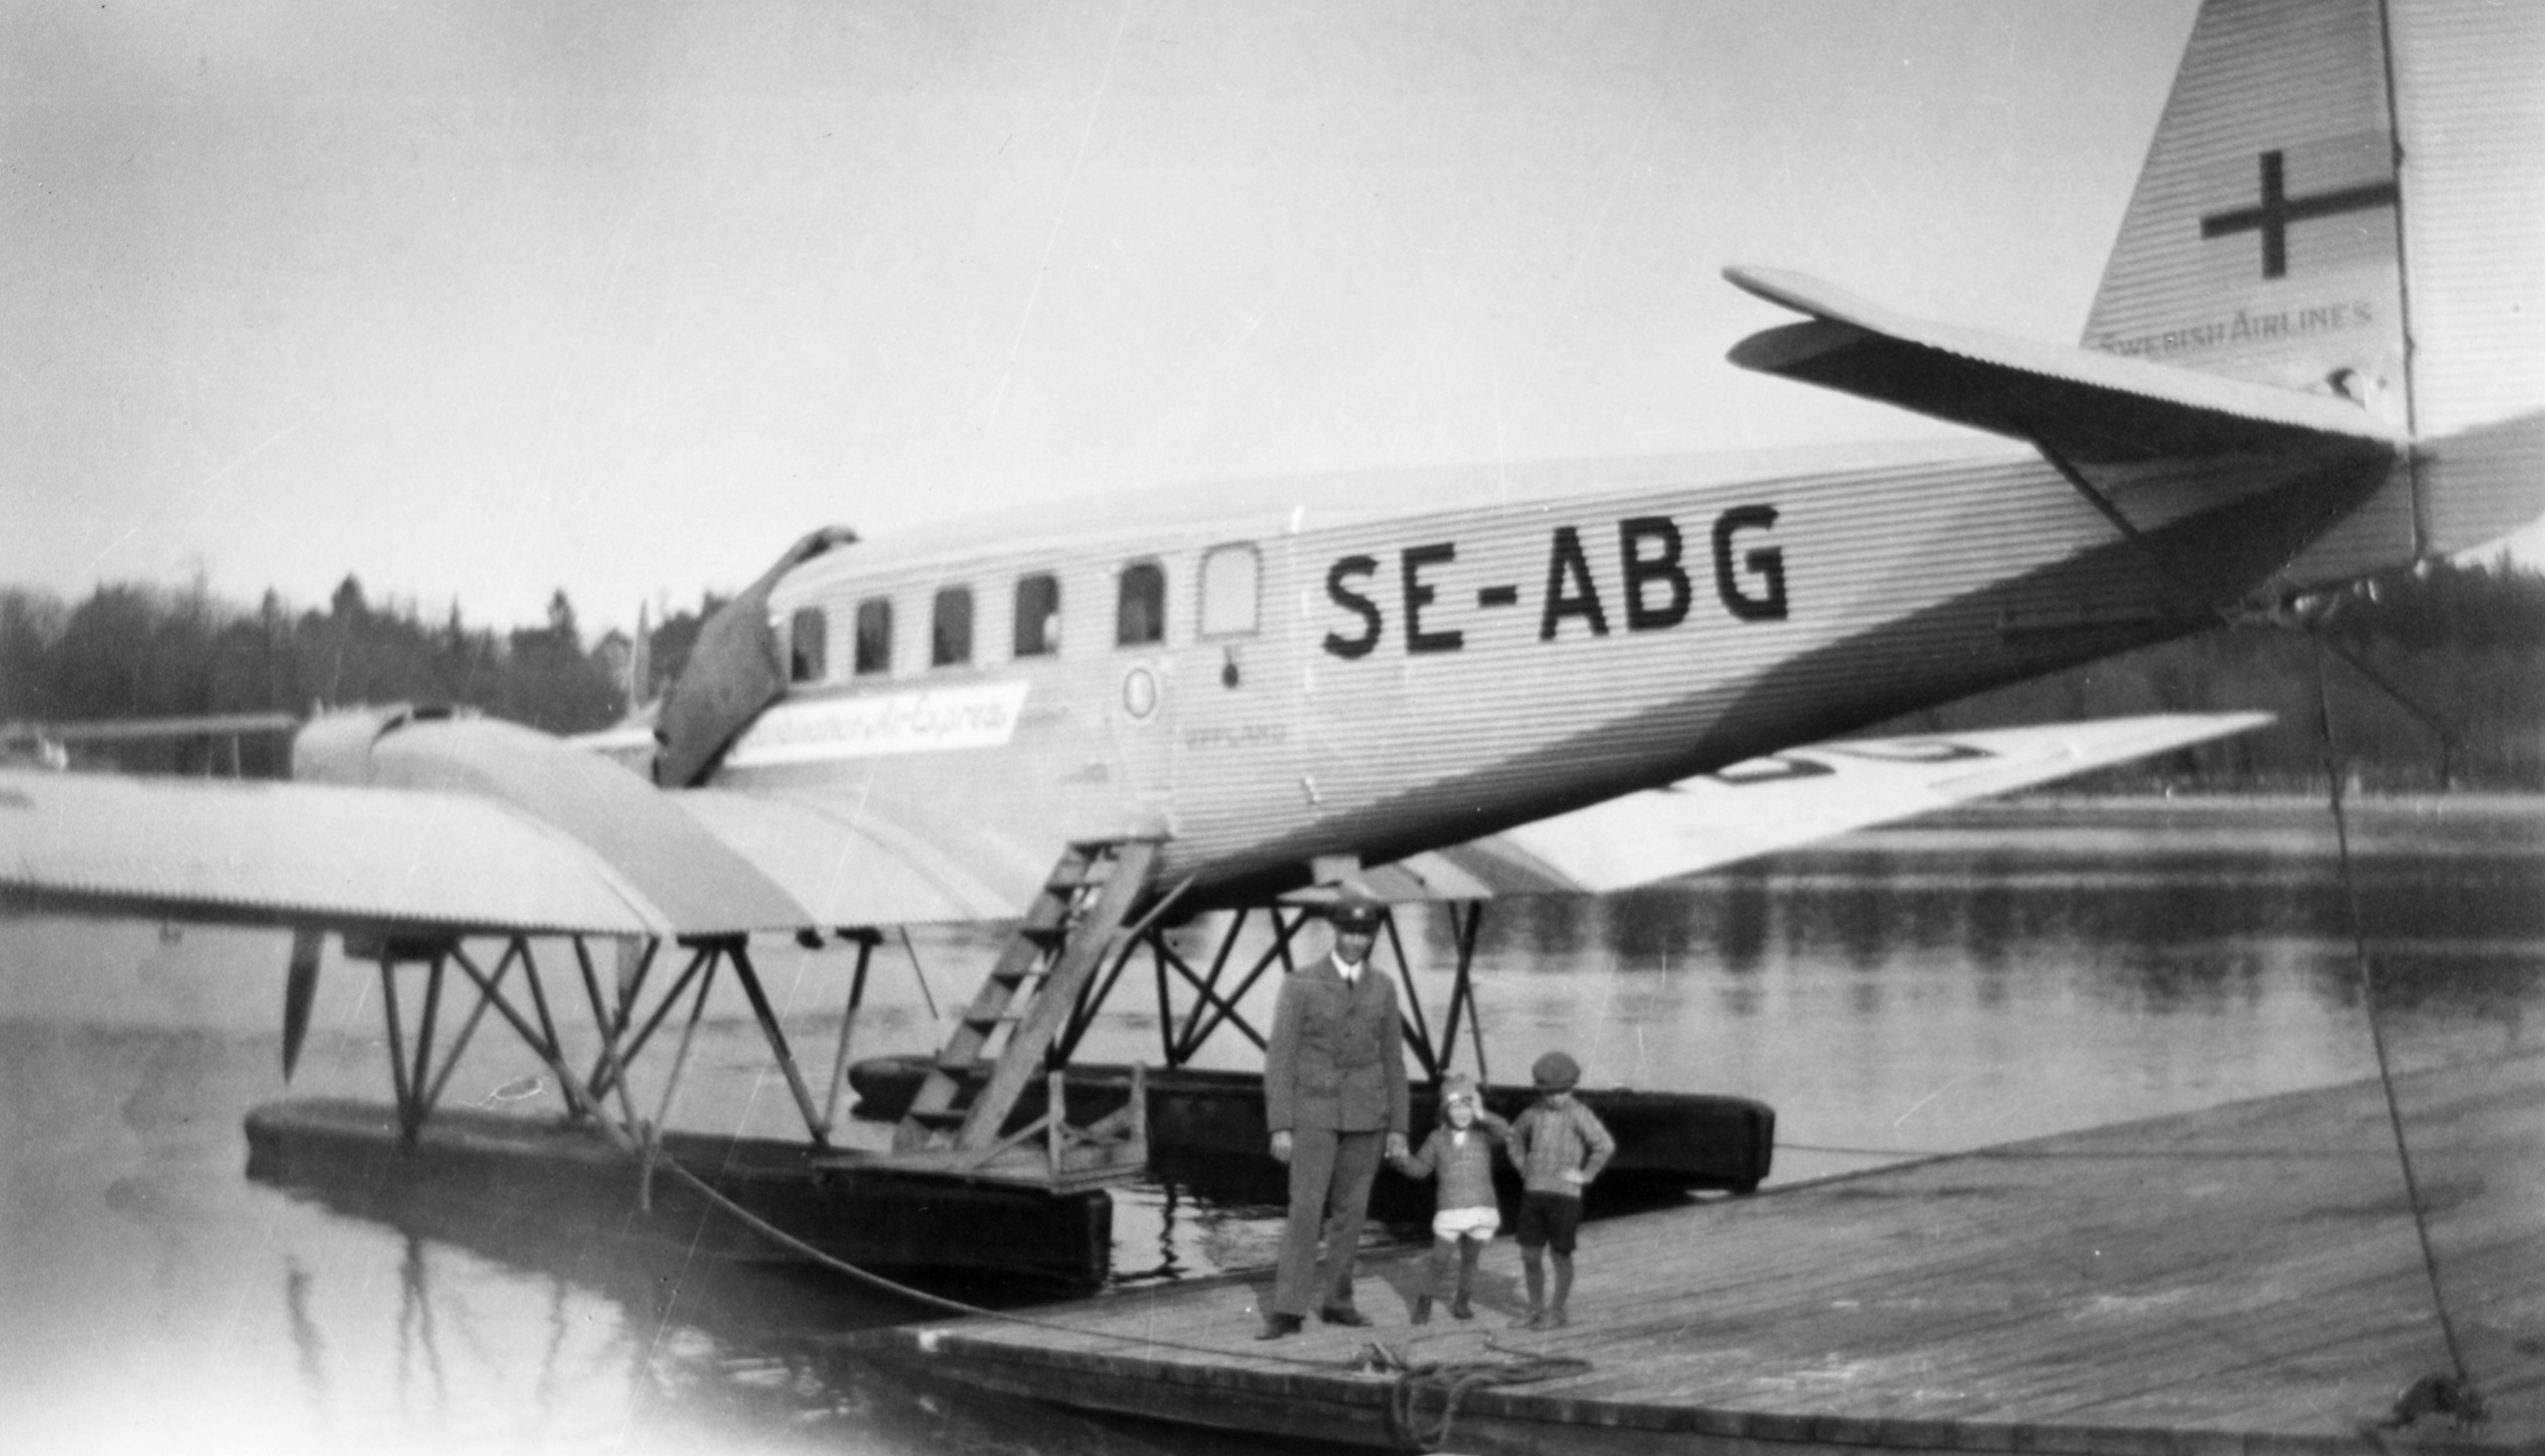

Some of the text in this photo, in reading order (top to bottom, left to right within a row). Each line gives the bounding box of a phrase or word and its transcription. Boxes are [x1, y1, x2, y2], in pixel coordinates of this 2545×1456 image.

[2099, 303, 2373, 357] SWEDISH AIRLINES
[1322, 504, 1789, 659] SE-ABG
